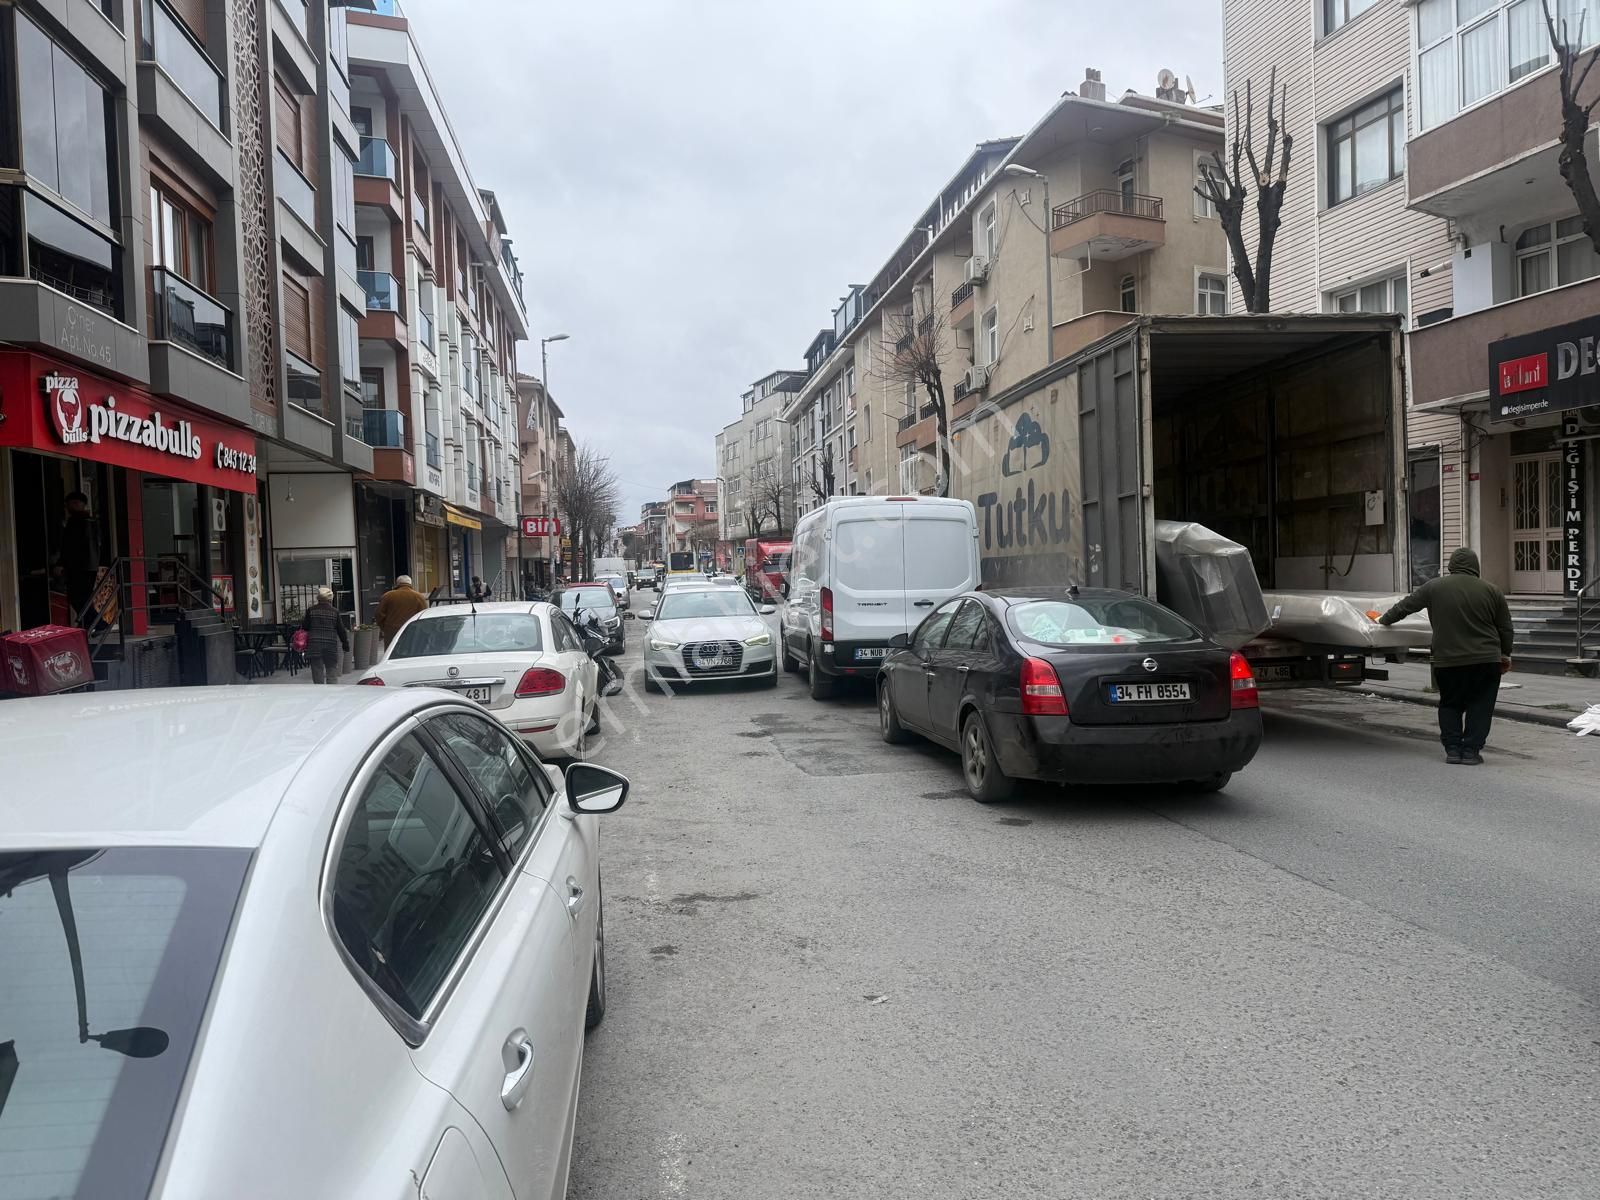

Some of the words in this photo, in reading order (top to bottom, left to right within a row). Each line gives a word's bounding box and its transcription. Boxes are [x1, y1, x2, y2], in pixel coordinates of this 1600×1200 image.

[1556, 336, 1600, 381] DE
[45, 371, 79, 393] pizza
[63, 427, 88, 443] bulls
[90, 395, 202, 460] pizzabulls
[224, 447, 237, 470] 843
[238, 450, 247, 471] 12
[248, 454, 256, 474] 34
[977, 478, 1071, 550] Tutku
[1566, 528, 1582, 592] PERDE
[859, 648, 868, 657] 34
[870, 648, 883, 657] NUB
[466, 688, 486, 699] 481
[1117, 686, 1132, 700] 34
[1136, 685, 1152, 699] FH
[1157, 684, 1187, 698] 8554
